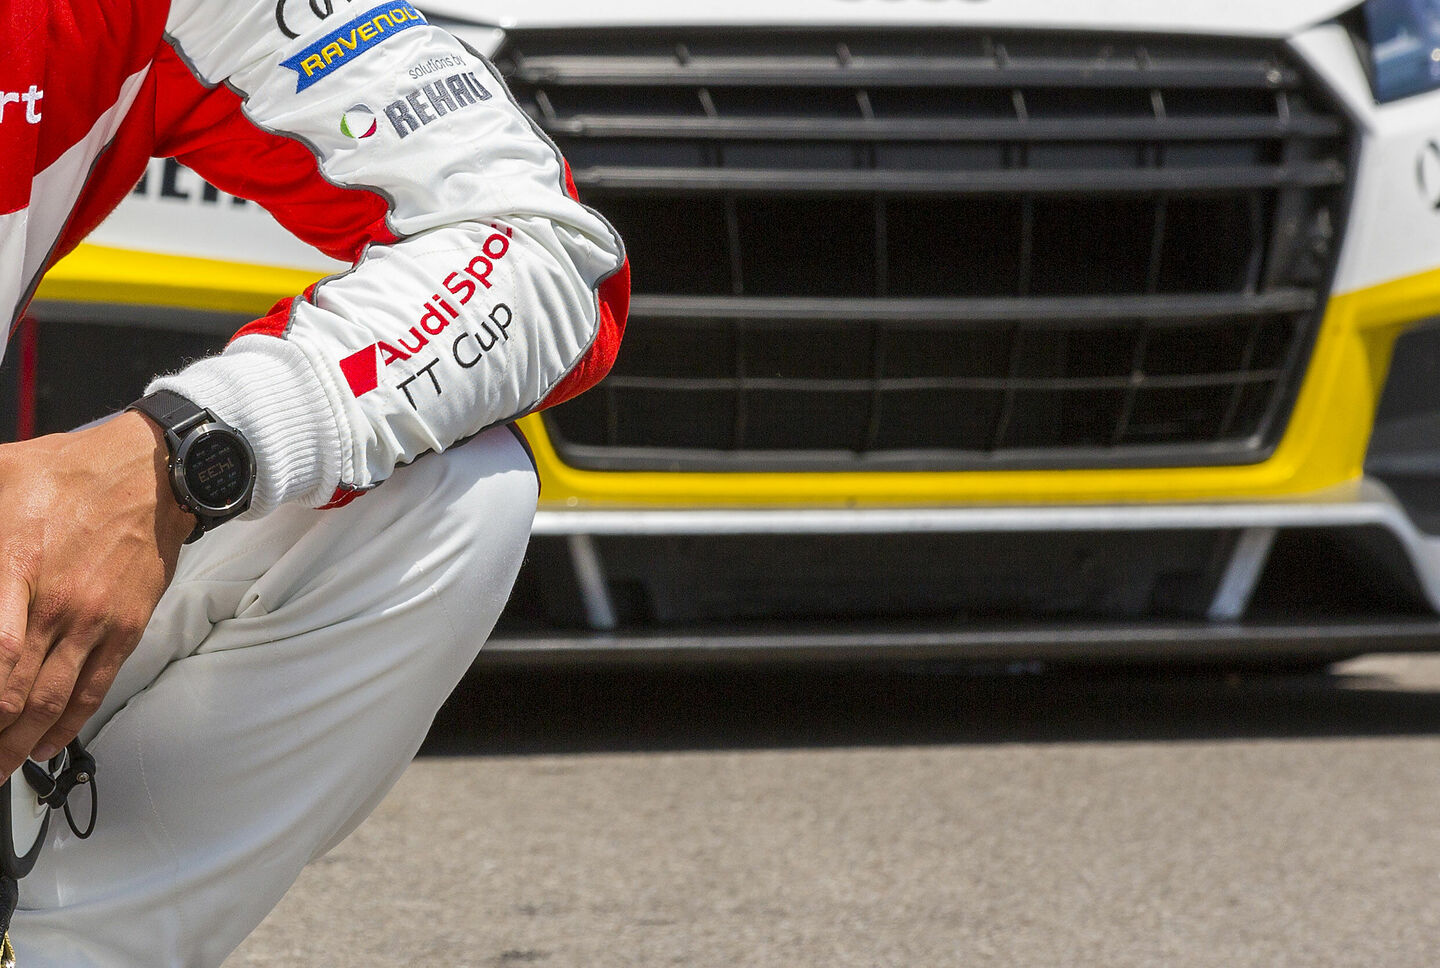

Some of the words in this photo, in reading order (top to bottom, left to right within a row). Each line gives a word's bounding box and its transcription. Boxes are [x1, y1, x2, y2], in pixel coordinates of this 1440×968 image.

[300, 6, 419, 77] RAVENOL
[409, 57, 454, 79] solutions
[384, 72, 492, 139] REHAU
[376, 293, 460, 367] Audi
[396, 357, 443, 411] TT
[452, 303, 513, 369] Cup
